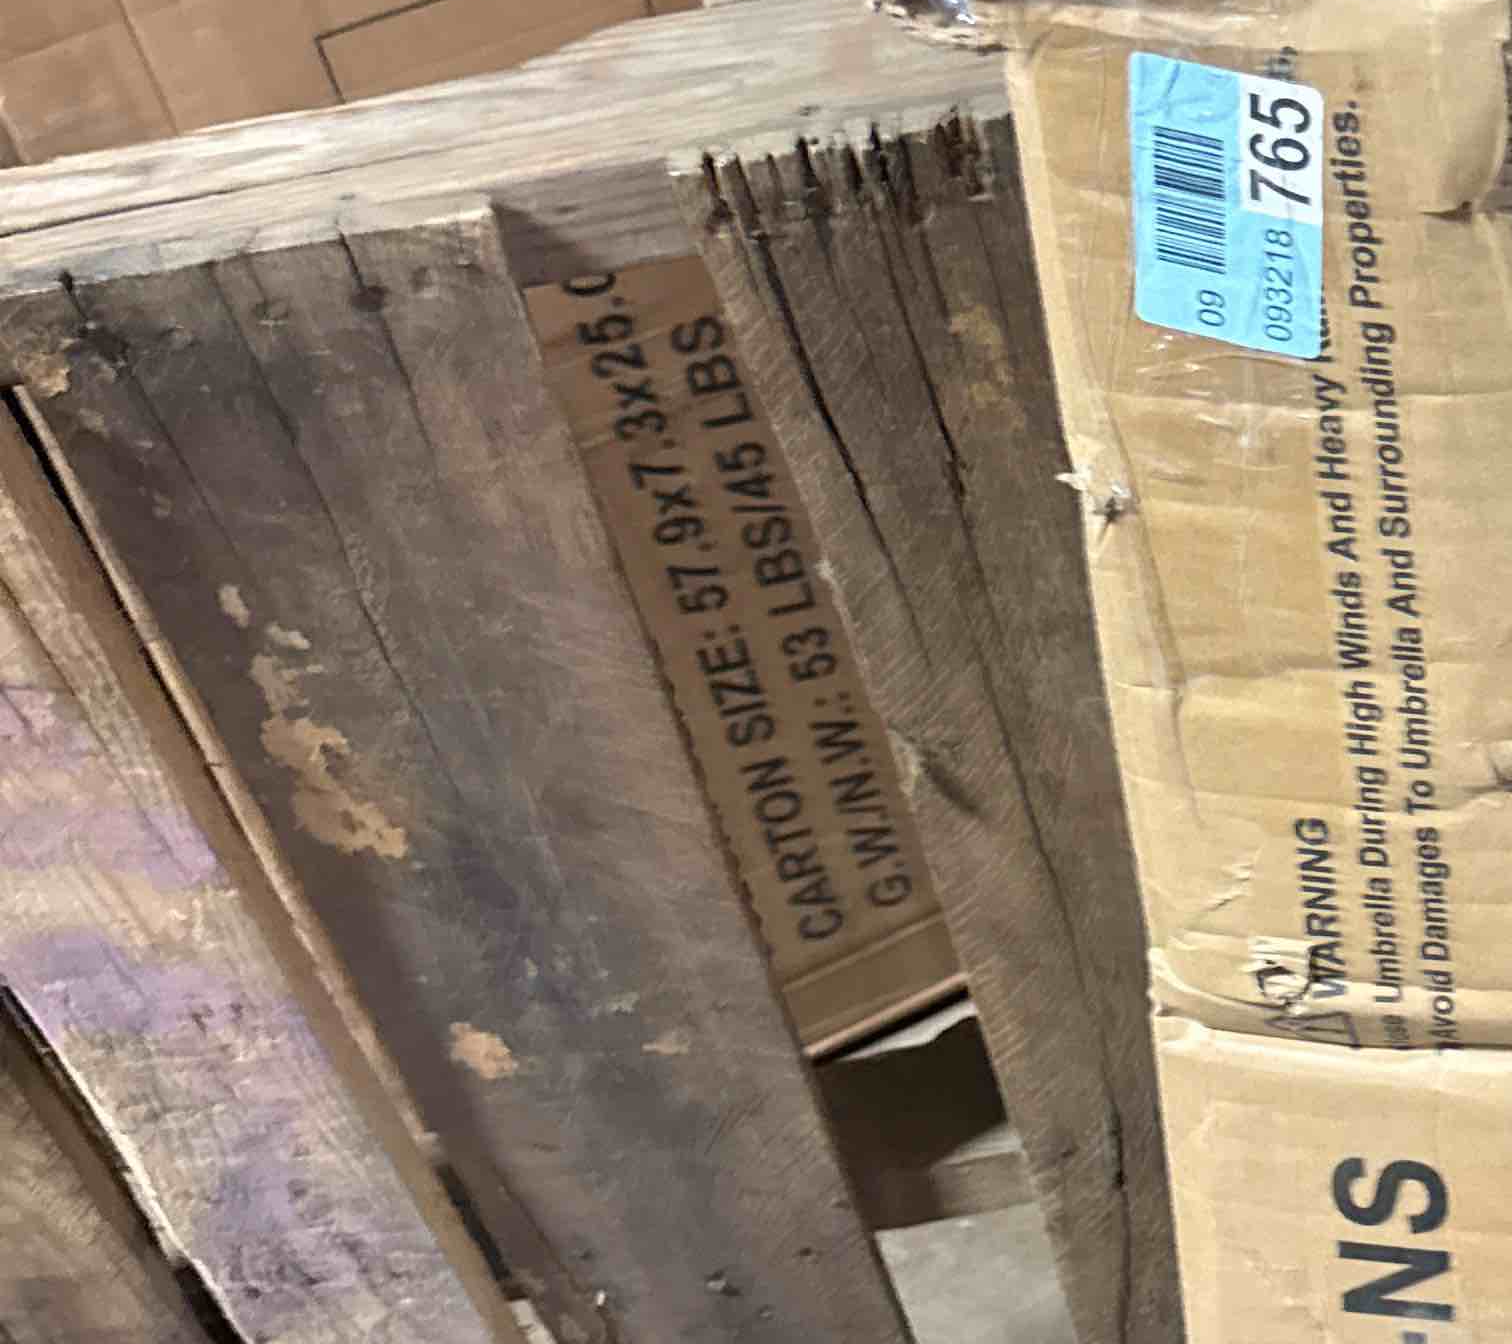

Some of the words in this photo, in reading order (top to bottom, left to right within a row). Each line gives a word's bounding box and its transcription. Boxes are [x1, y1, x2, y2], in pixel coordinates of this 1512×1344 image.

[1249, 92, 1312, 205] 765
[1330, 100, 1385, 309] Properties.
[1199, 289, 1226, 327] 09
[1264, 228, 1295, 342] 093218
[671, 315, 755, 429] LBS
[1313, 374, 1349, 480] Heavy
[1360, 322, 1412, 538] Surrounding
[713, 440, 817, 616] LBS/45
[1320, 491, 1359, 561] And
[1331, 571, 1371, 671] Winds
[1380, 549, 1420, 617] And
[696, 624, 776, 747] SIZE:
[781, 626, 837, 682] 53
[1390, 626, 1431, 769] Umbrella
[1344, 679, 1384, 757] High
[738, 757, 844, 941] CARTON
[1353, 767, 1391, 868] During
[1404, 780, 1438, 815] To
[1294, 817, 1347, 999] WARNING
[1362, 877, 1403, 1003] Umbrella
[1414, 826, 1452, 962] Damages
[1421, 969, 1458, 1040] Avoid
